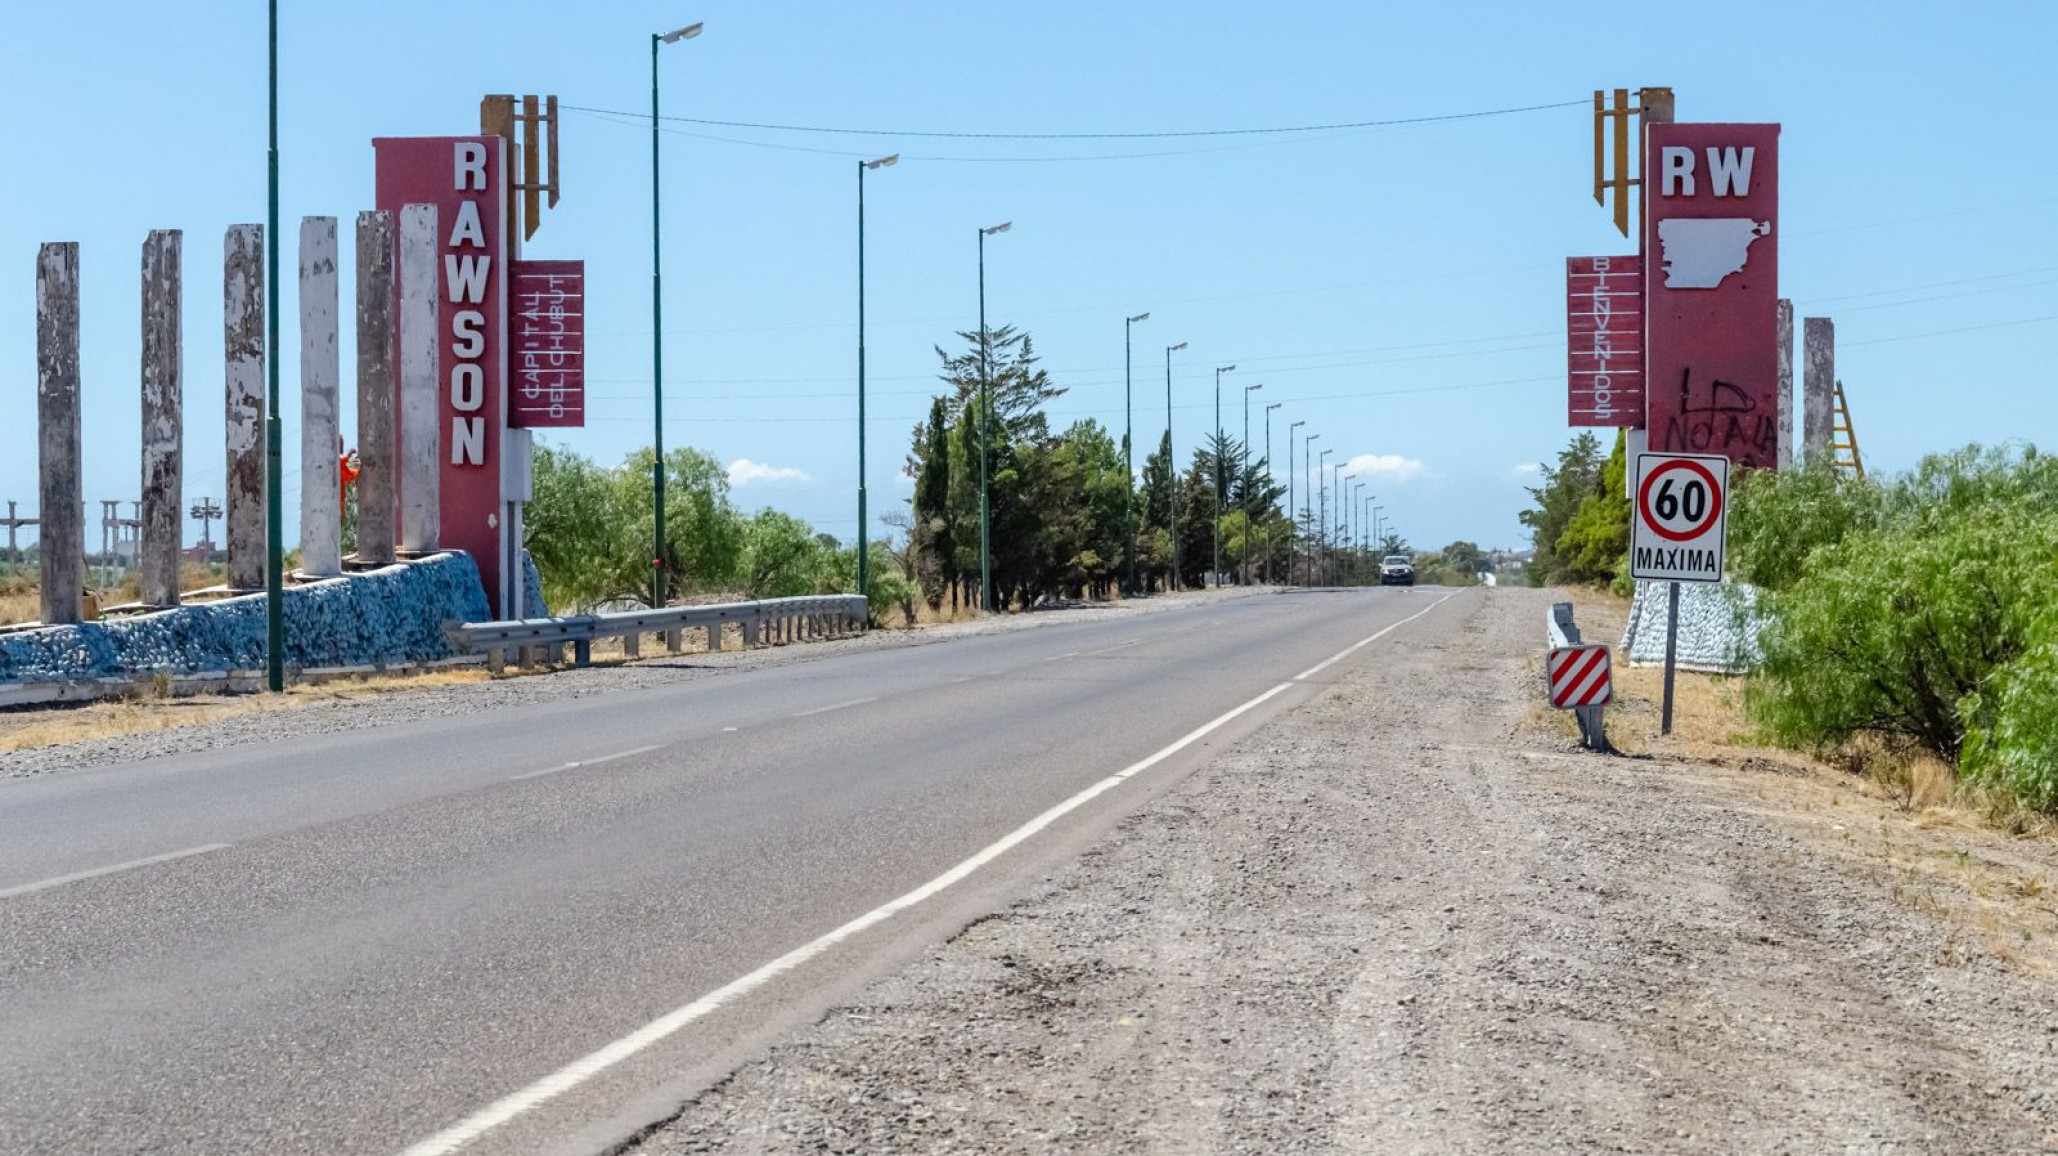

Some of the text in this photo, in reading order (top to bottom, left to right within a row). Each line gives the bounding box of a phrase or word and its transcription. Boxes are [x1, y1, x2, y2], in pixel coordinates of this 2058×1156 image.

[1662, 146, 1755, 197] RW
[444, 142, 491, 465] RAWSON
[525, 291, 541, 399] CAPITAL
[550, 274, 565, 418] DEL CHUBUT
[1593, 257, 1612, 420] BIENVENIDOS
[1655, 478, 1705, 523] 60
[1636, 547, 1716, 573] MAXIMA
